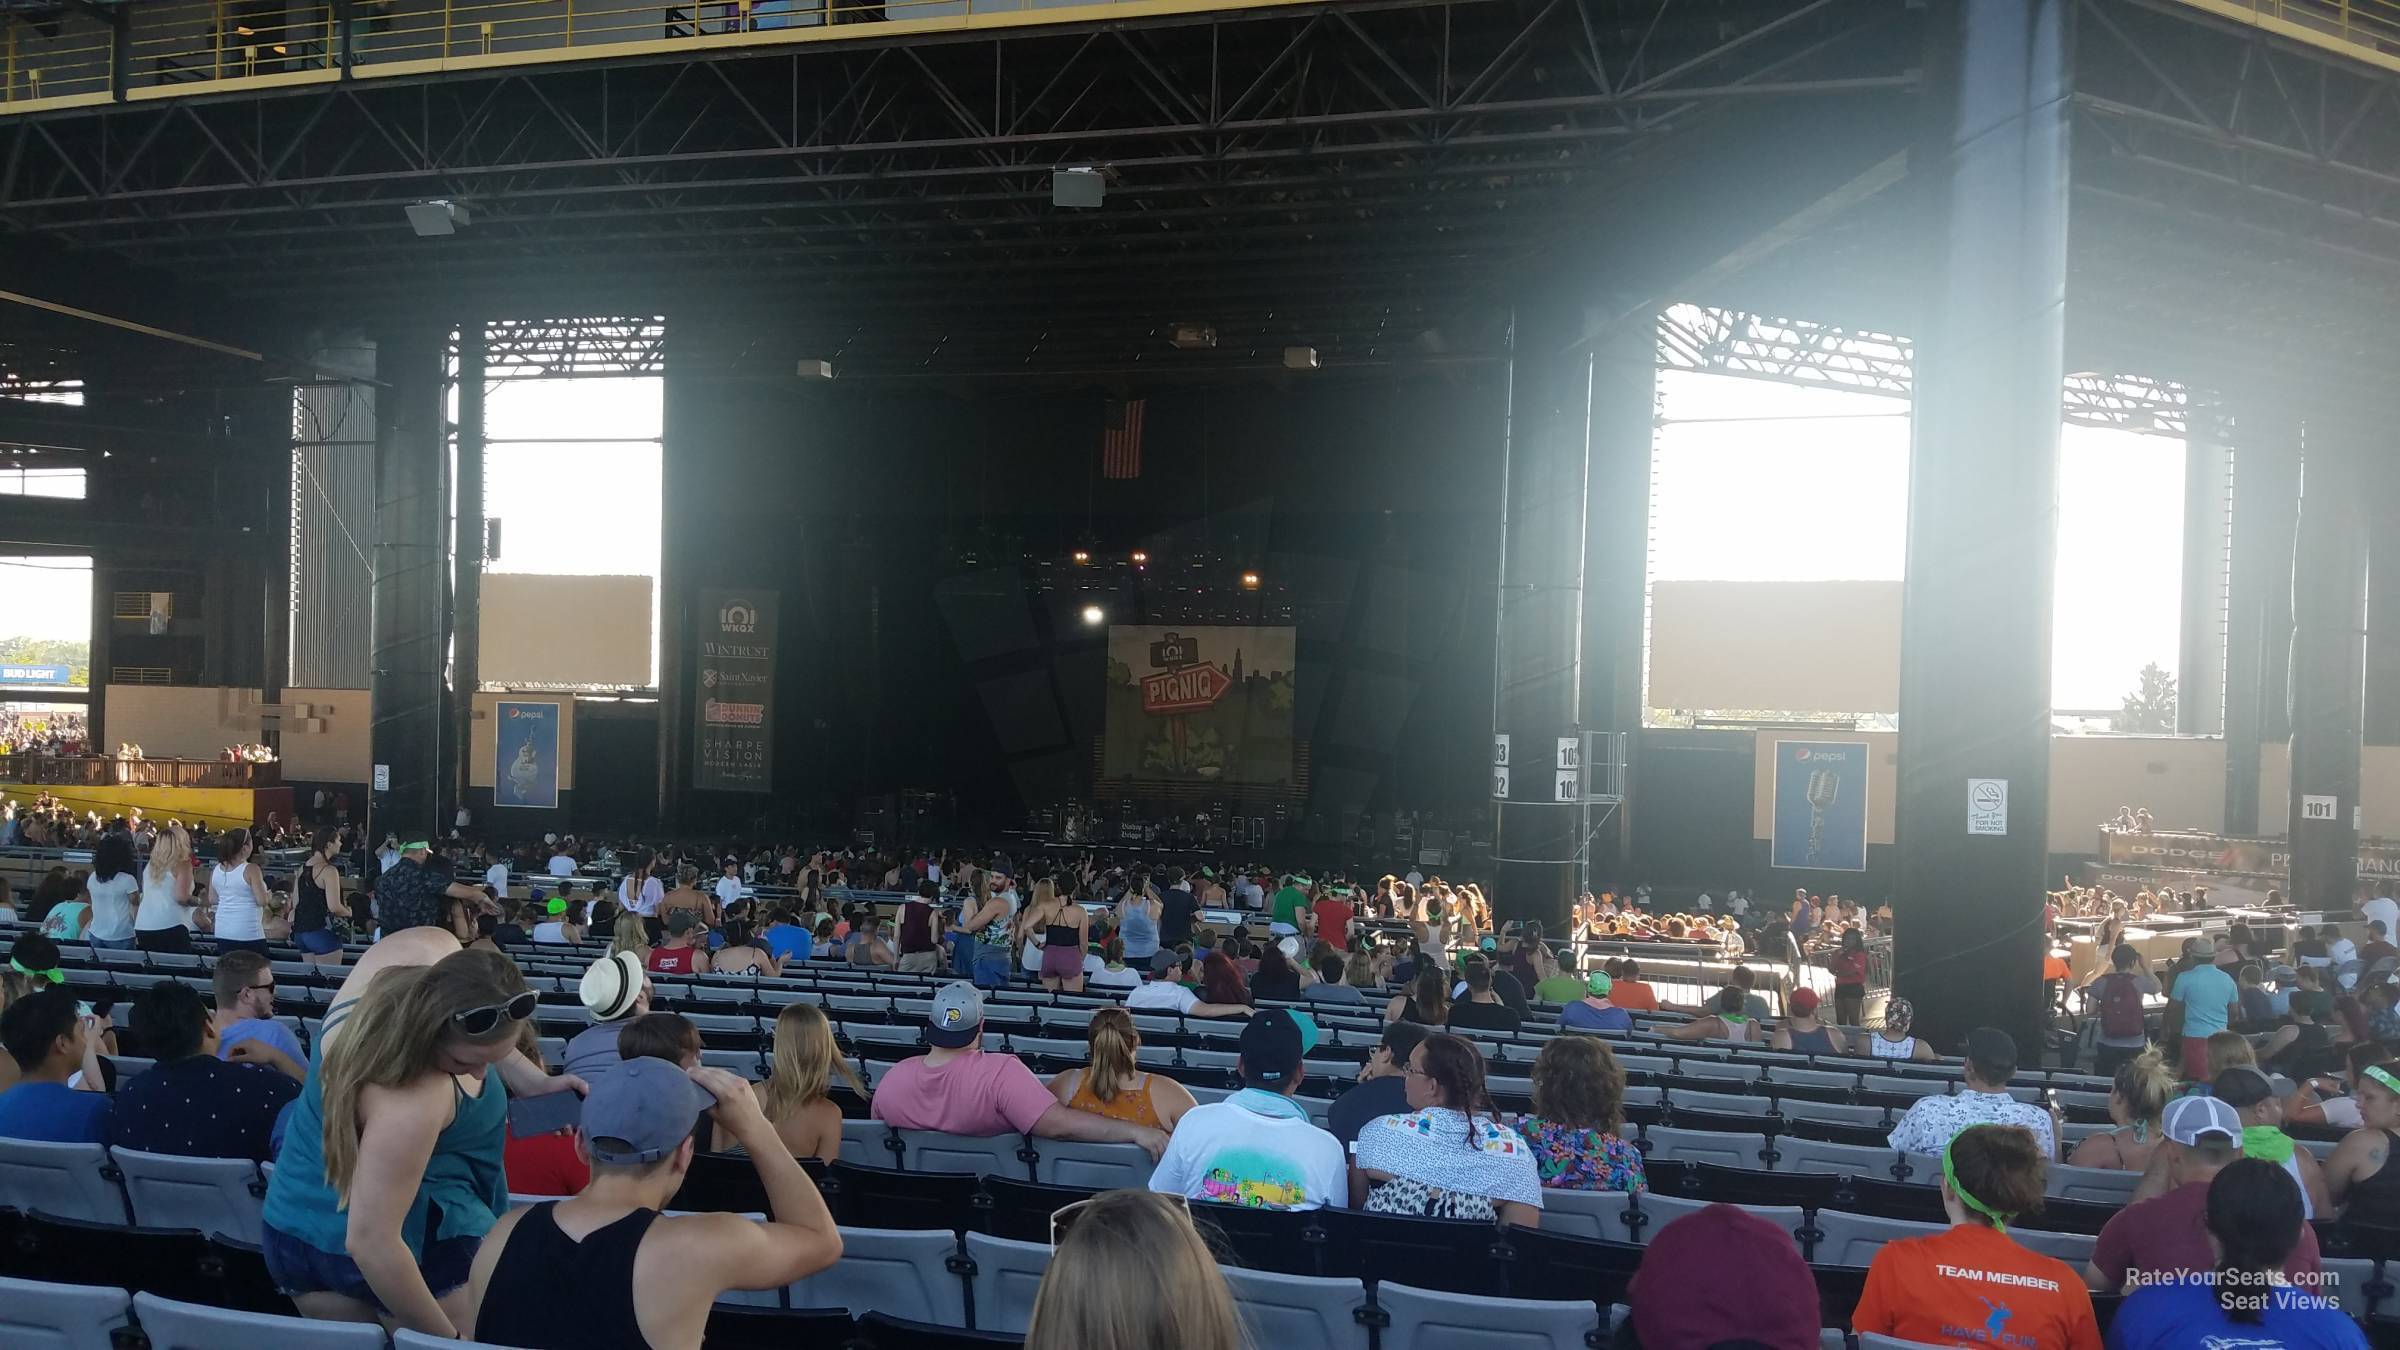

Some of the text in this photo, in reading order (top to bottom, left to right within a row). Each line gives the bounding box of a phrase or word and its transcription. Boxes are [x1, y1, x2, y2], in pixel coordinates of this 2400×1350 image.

[721, 623, 754, 633] WKQX
[3, 668, 56, 679] BUD LIGHT
[1149, 671, 1211, 702] PIQNIQ
[520, 711, 543, 720] pepsi
[704, 739, 763, 750] SHARPE
[704, 749, 762, 760] VISION
[1813, 751, 1846, 763] pepsi
[2306, 802, 2331, 817] 101
[2131, 845, 2225, 859] DODGE
[1935, 1264, 2060, 1293] TEAM MEMBER
[1941, 1324, 2037, 1350] HAVE FUN
